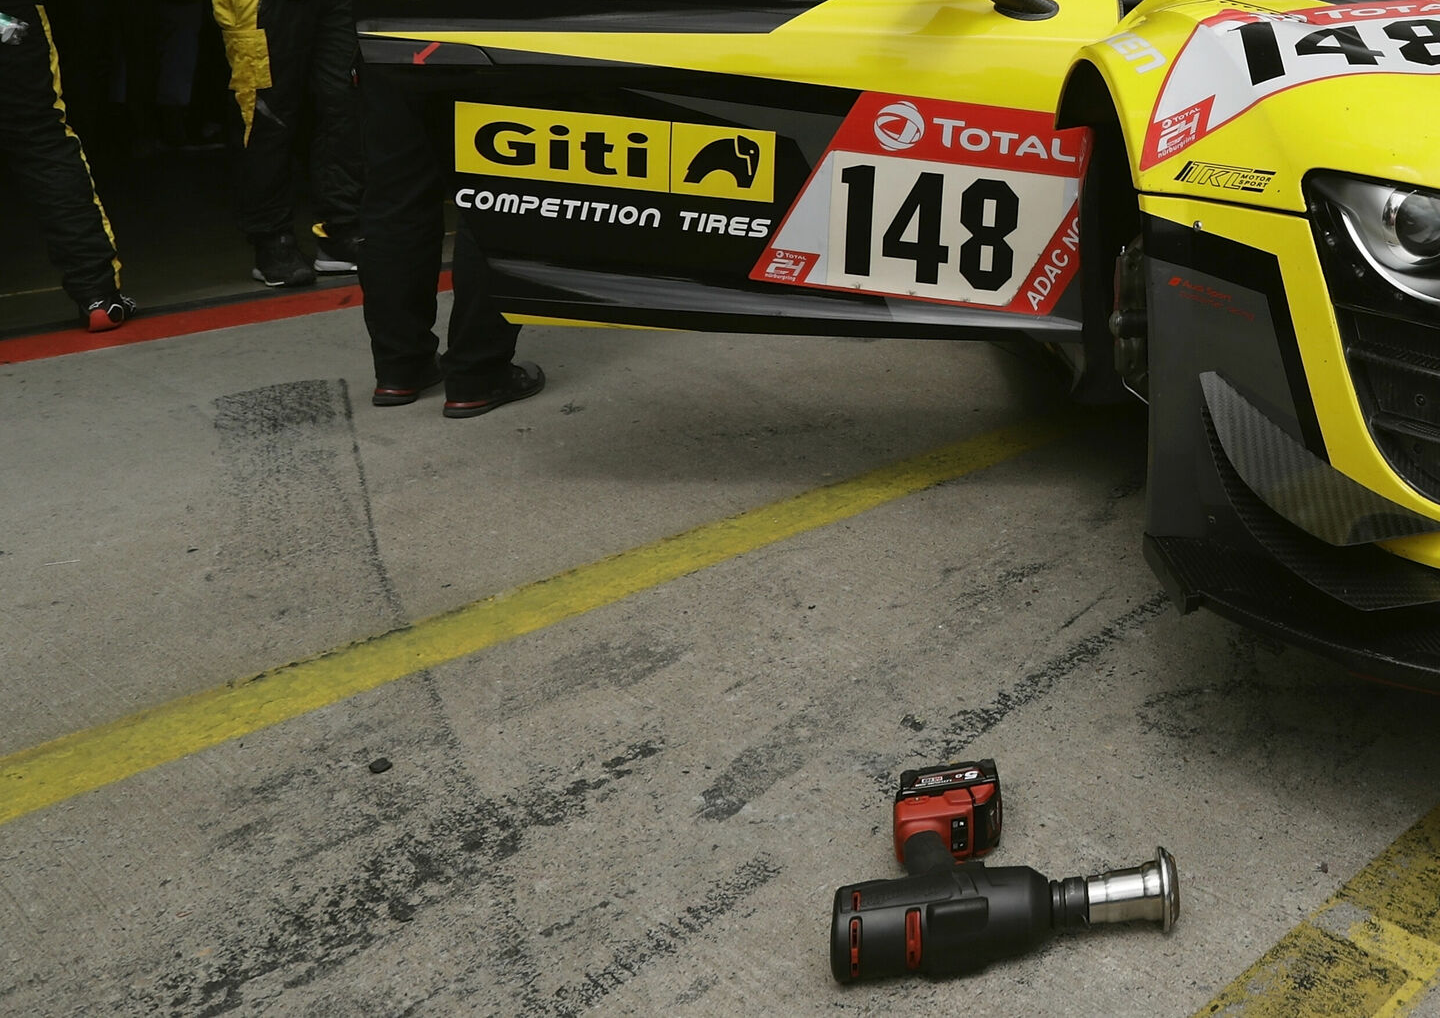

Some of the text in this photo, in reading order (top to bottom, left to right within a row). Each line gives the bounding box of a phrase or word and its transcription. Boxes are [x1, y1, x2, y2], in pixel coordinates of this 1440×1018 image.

[1173, 107, 1201, 123] TOTAL
[473, 120, 650, 179] Giti
[932, 116, 1077, 163] TOTAL
[1157, 134, 1196, 158] nürburgring
[1239, 179, 1268, 188] SPORT
[1241, 173, 1271, 182] MOTOR
[454, 188, 772, 239] COMPETITION TIRES
[841, 164, 1021, 292] 148
[785, 252, 807, 261] TOTAL
[1026, 249, 1069, 311] ADAC
